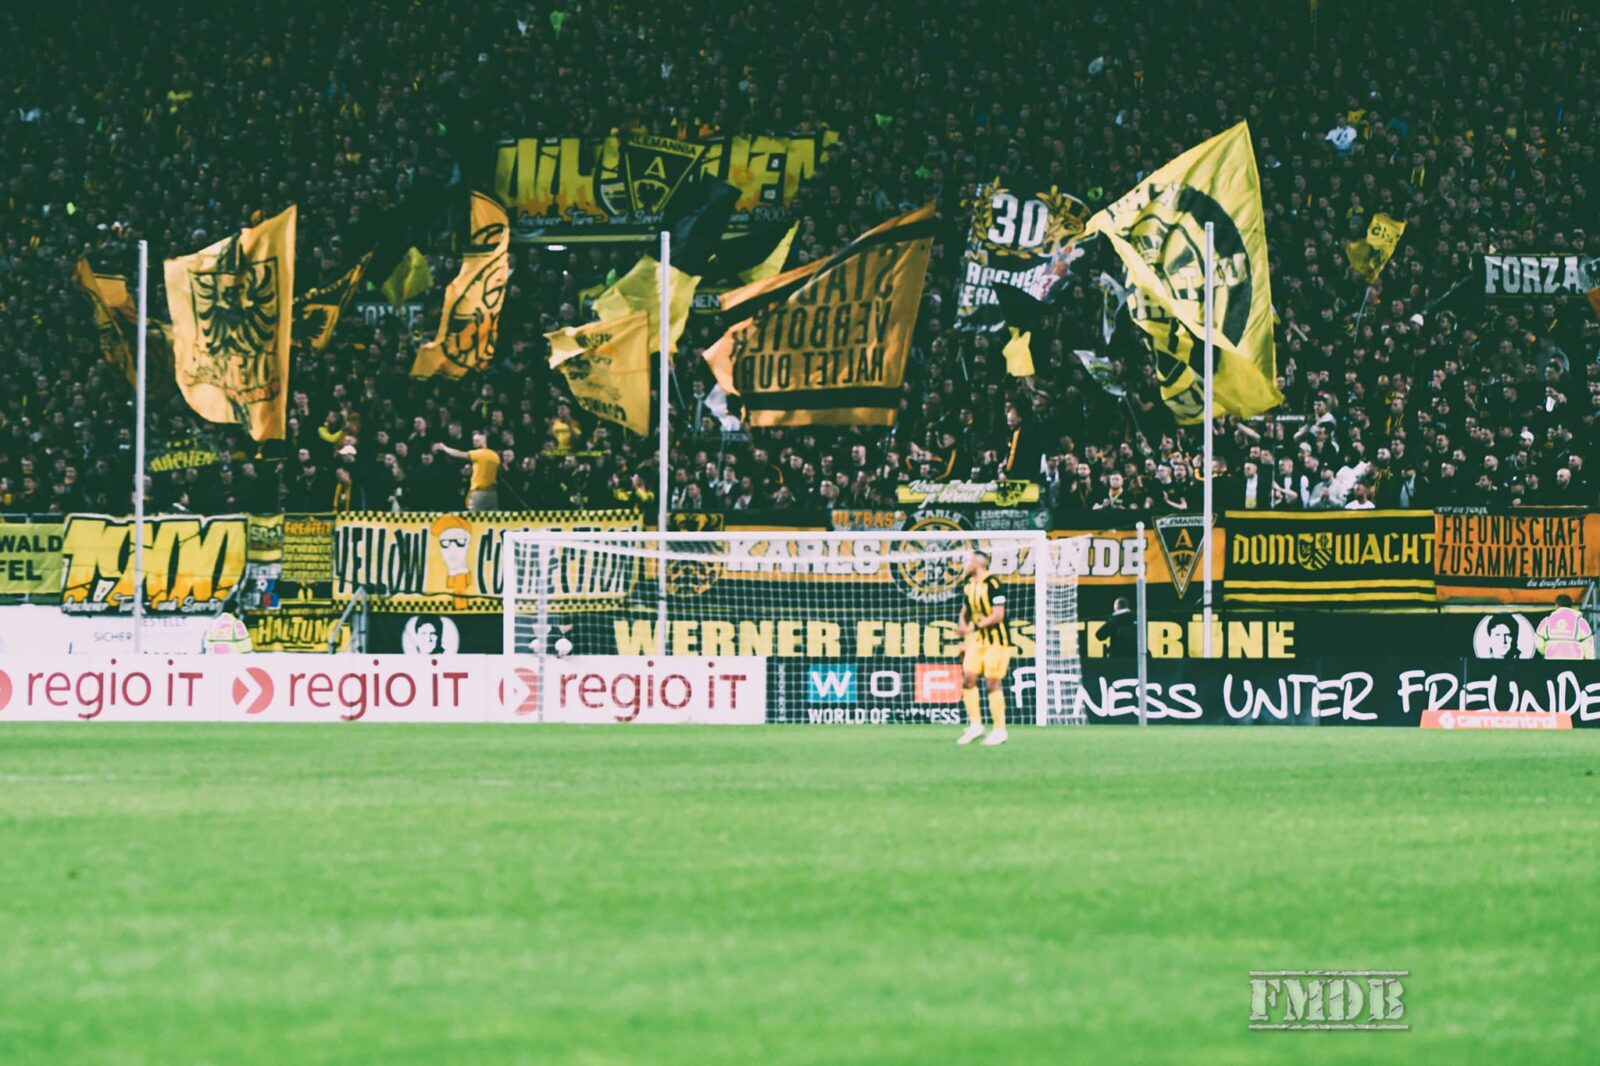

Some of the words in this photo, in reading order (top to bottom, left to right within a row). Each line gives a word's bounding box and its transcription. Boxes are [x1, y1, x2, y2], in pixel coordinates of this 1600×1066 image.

[644, 156, 666, 179] A
[987, 193, 1048, 248] 30
[1484, 255, 1586, 293] FORZA
[831, 509, 895, 529] ULTRAS
[1175, 528, 1193, 548] A
[1441, 514, 1586, 547] FREUNDSCHAFT
[334, 525, 429, 595] YELLOW
[1233, 533, 1296, 565] DOM
[1335, 533, 1436, 565] WACHT
[1439, 544, 1587, 577] ZUSAMMENHALT
[613, 619, 841, 657] WERNER
[856, 620, 1036, 658] FUCS
[1053, 613, 1296, 659] TRBÜNE
[28, 658, 152, 720] regio
[289, 658, 417, 721] regio
[560, 660, 692, 722] regio
[1010, 666, 1204, 720] FTNESS
[1223, 672, 1378, 720] UNTER
[808, 708, 866, 724] WORLD
[869, 708, 891, 724] OF
